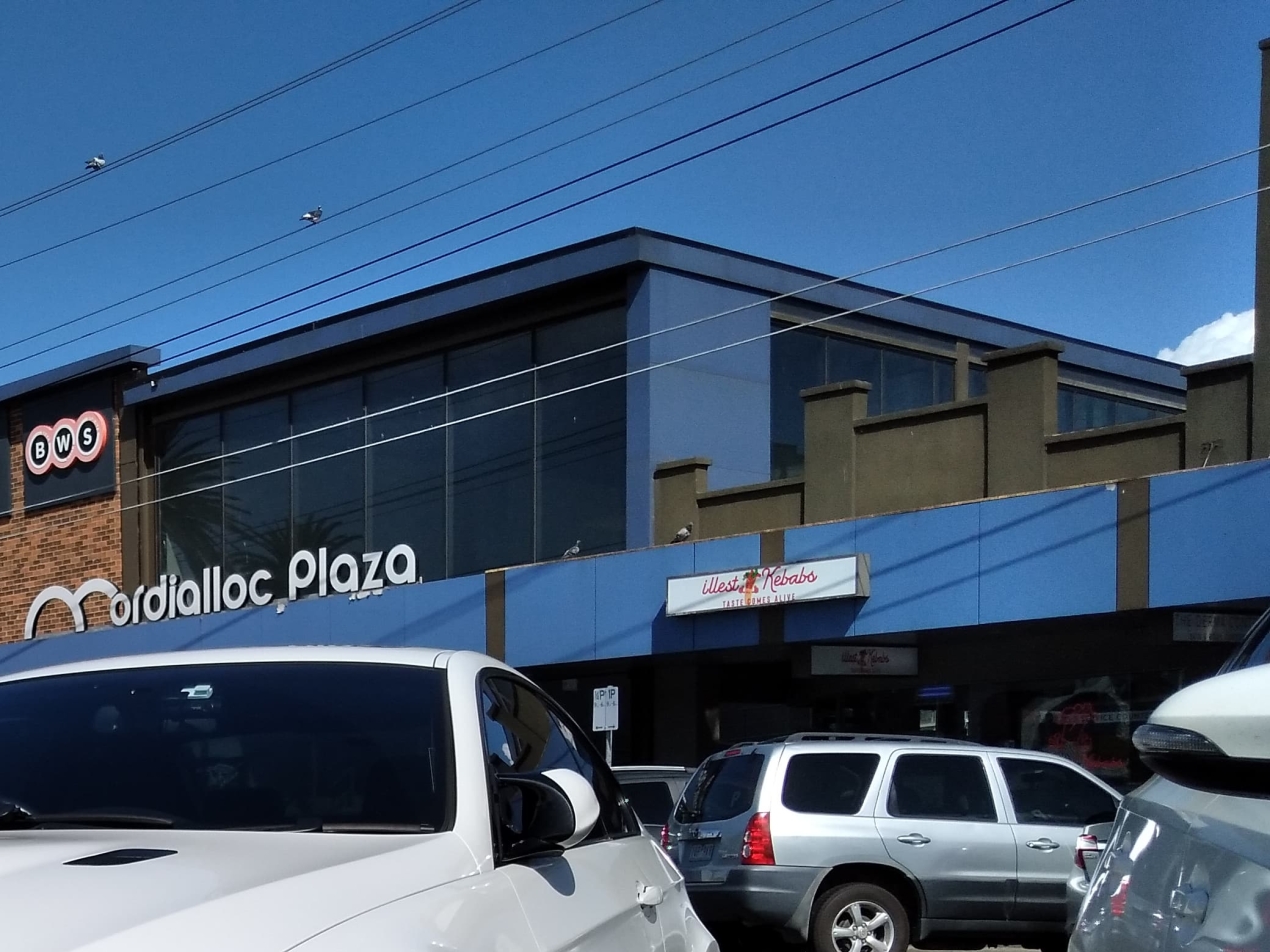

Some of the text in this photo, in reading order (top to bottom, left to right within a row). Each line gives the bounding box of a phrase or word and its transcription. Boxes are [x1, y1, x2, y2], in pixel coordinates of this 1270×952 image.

[35, 427, 93, 460] BWS
[288, 543, 417, 601] Plaza
[702, 565, 818, 595] illest Kebabs
[722, 592, 796, 608] TASTE COMES ALIVE
